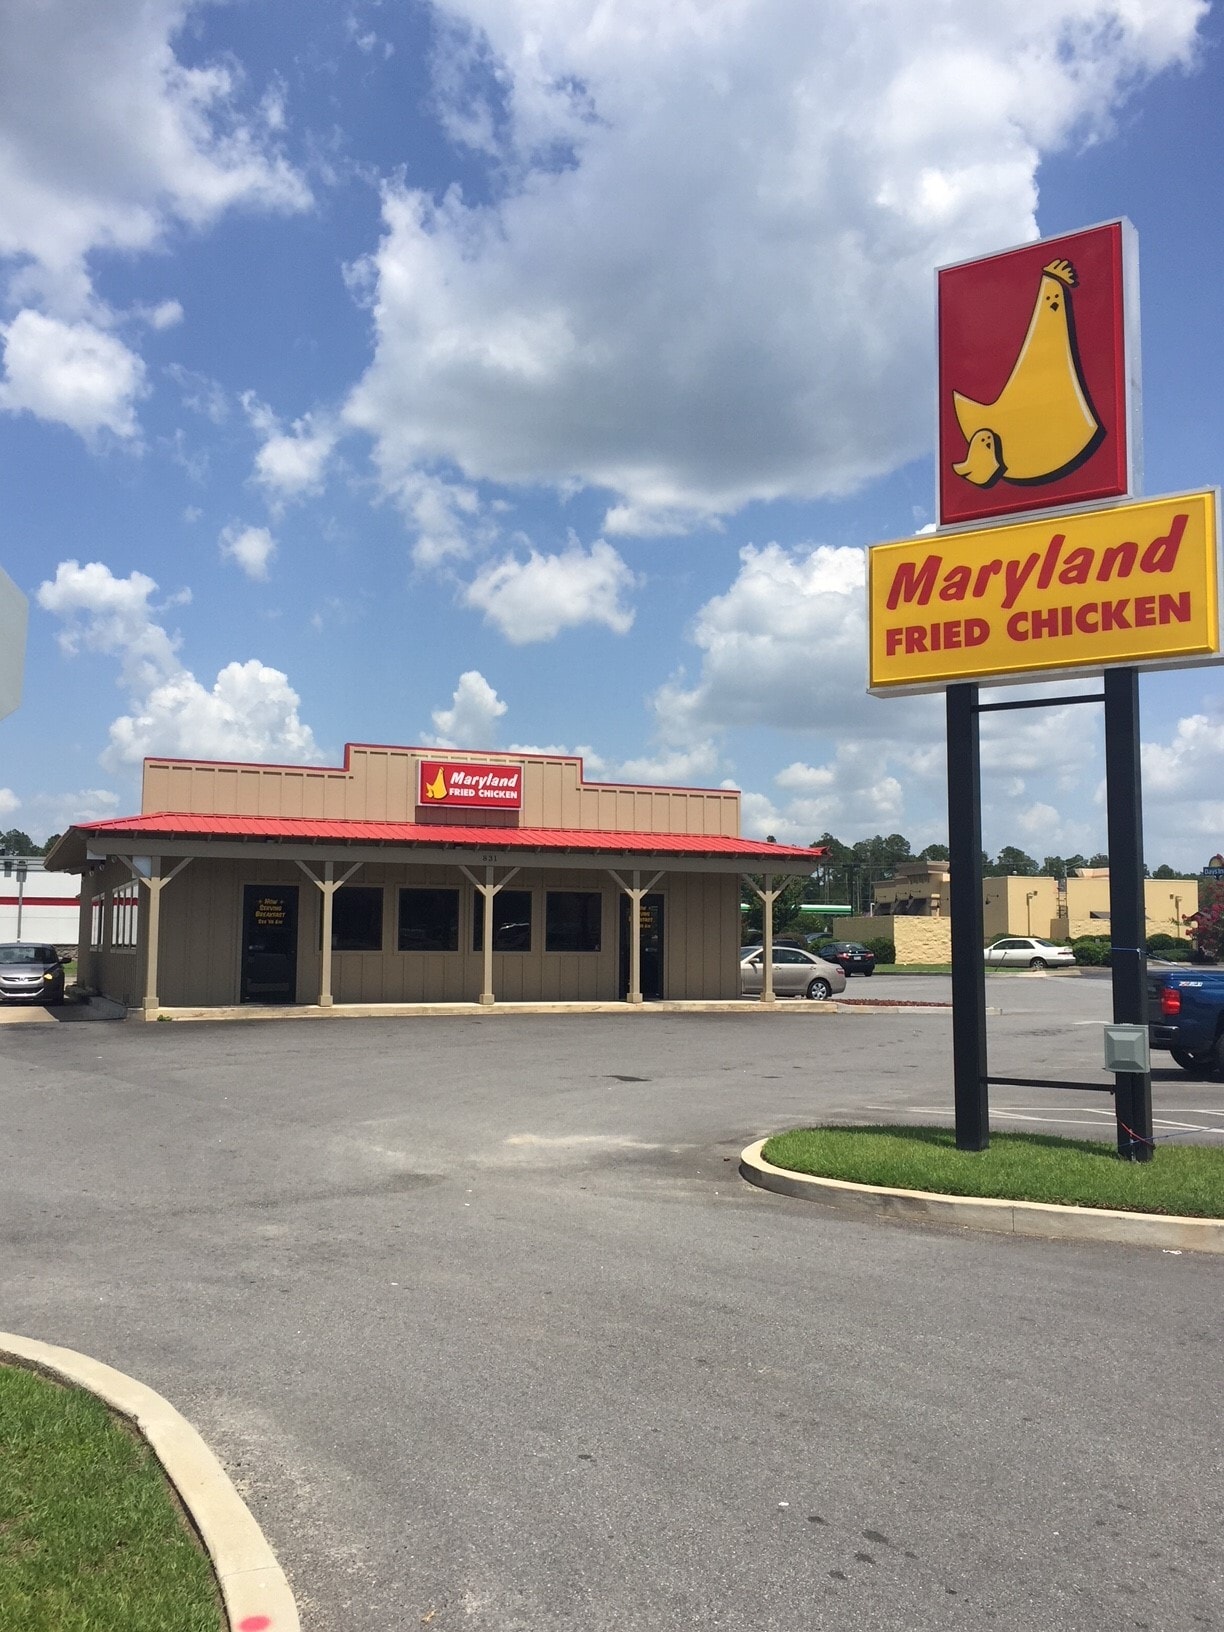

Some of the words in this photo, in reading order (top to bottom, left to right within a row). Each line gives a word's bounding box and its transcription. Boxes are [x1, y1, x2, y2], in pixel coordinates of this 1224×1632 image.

[886, 514, 1189, 611] Maryland
[886, 618, 990, 657] FRIED
[1006, 591, 1192, 642] CHICKEN
[449, 788, 475, 797] FRIED
[478, 790, 518, 799] CHICKEN
[450, 771, 518, 789] Maryland
